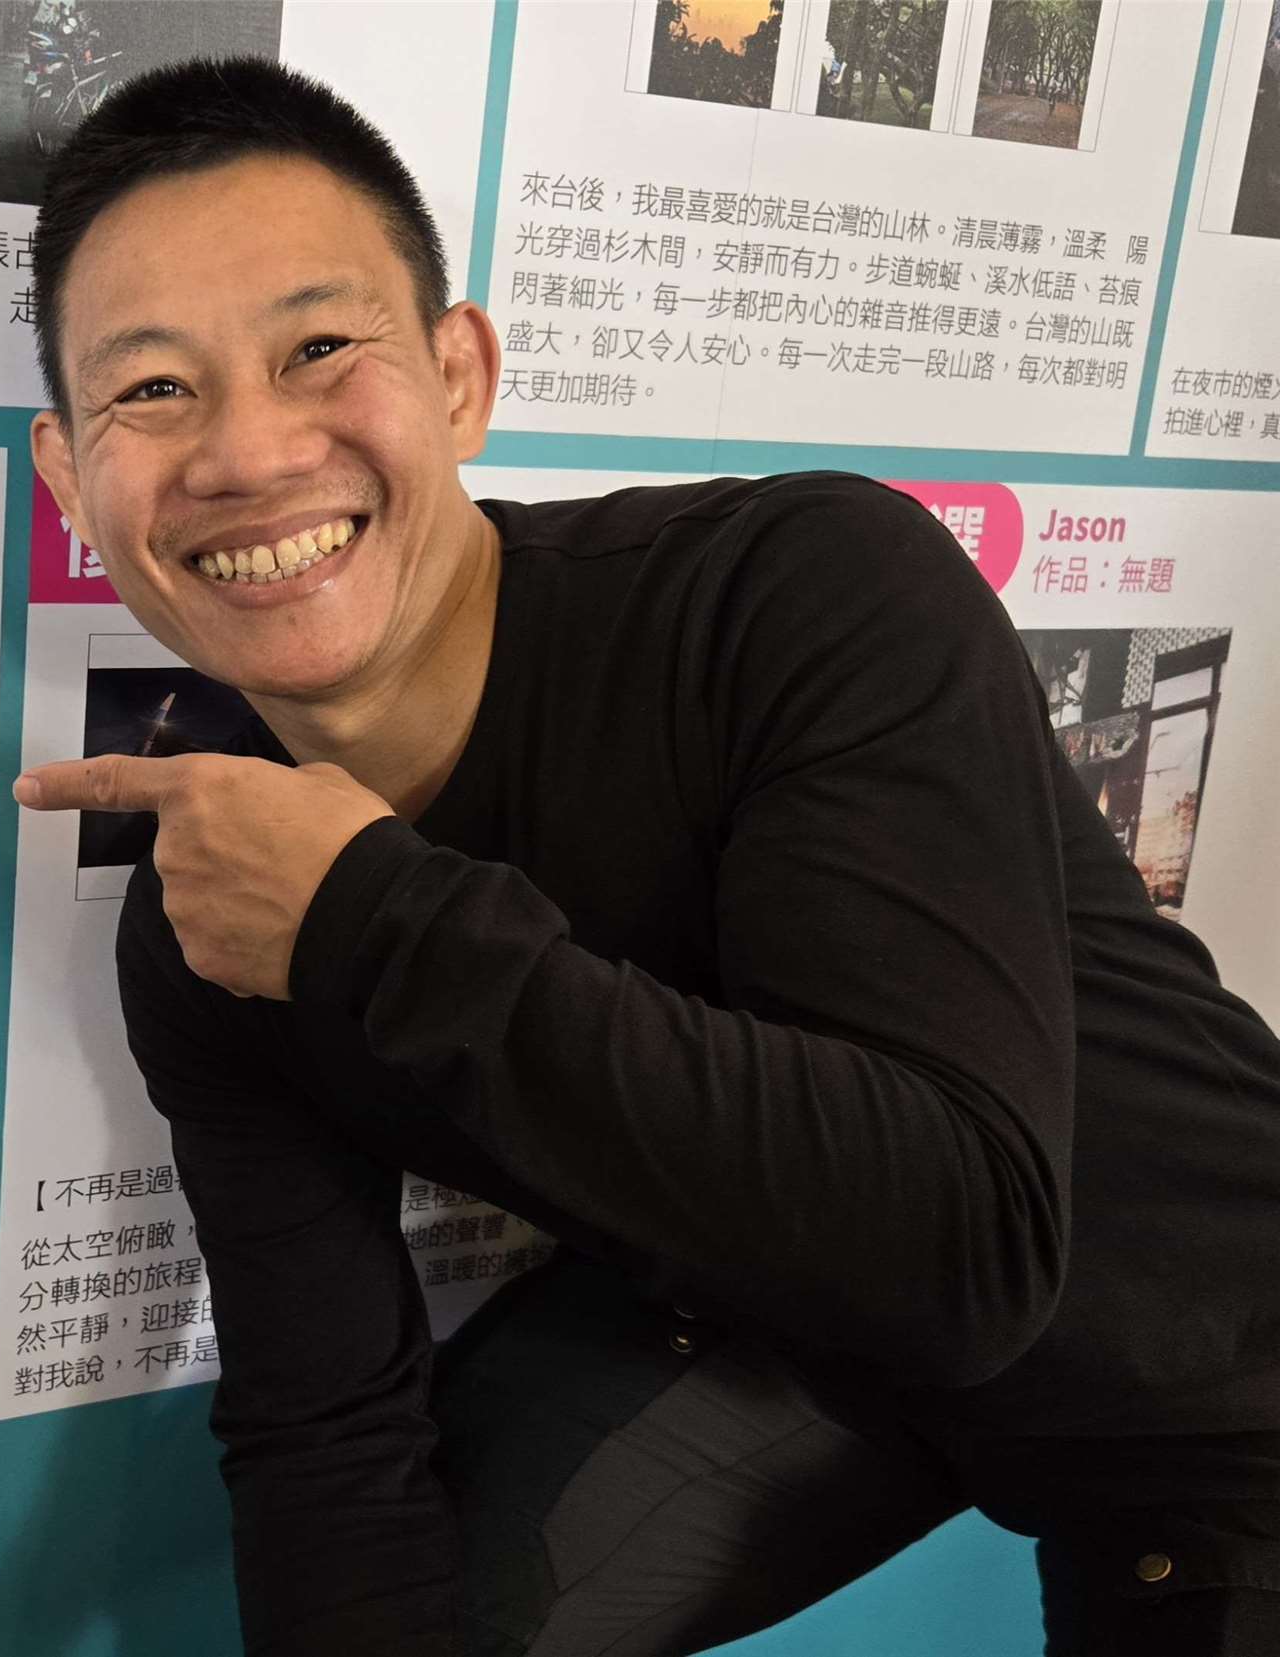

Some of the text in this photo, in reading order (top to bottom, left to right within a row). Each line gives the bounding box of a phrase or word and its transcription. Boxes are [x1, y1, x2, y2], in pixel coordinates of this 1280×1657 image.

[504, 319, 1129, 390] 盛大，卻又令人安心。每一次走完一段山路，每次都對明
[500, 368, 655, 407] 天更加期待。
[1163, 406, 1280, 441] 拍進心裡，真
[1038, 509, 1127, 543] Jason
[1031, 553, 1177, 594] 作品：無題
[35, 1164, 184, 1213] 【不再是過
[20, 1184, 485, 1271] 從太空俯瞰， 是極
[19, 1256, 202, 1314] 分轉換的旅程
[13, 1334, 220, 1397] 對我說，不再是
